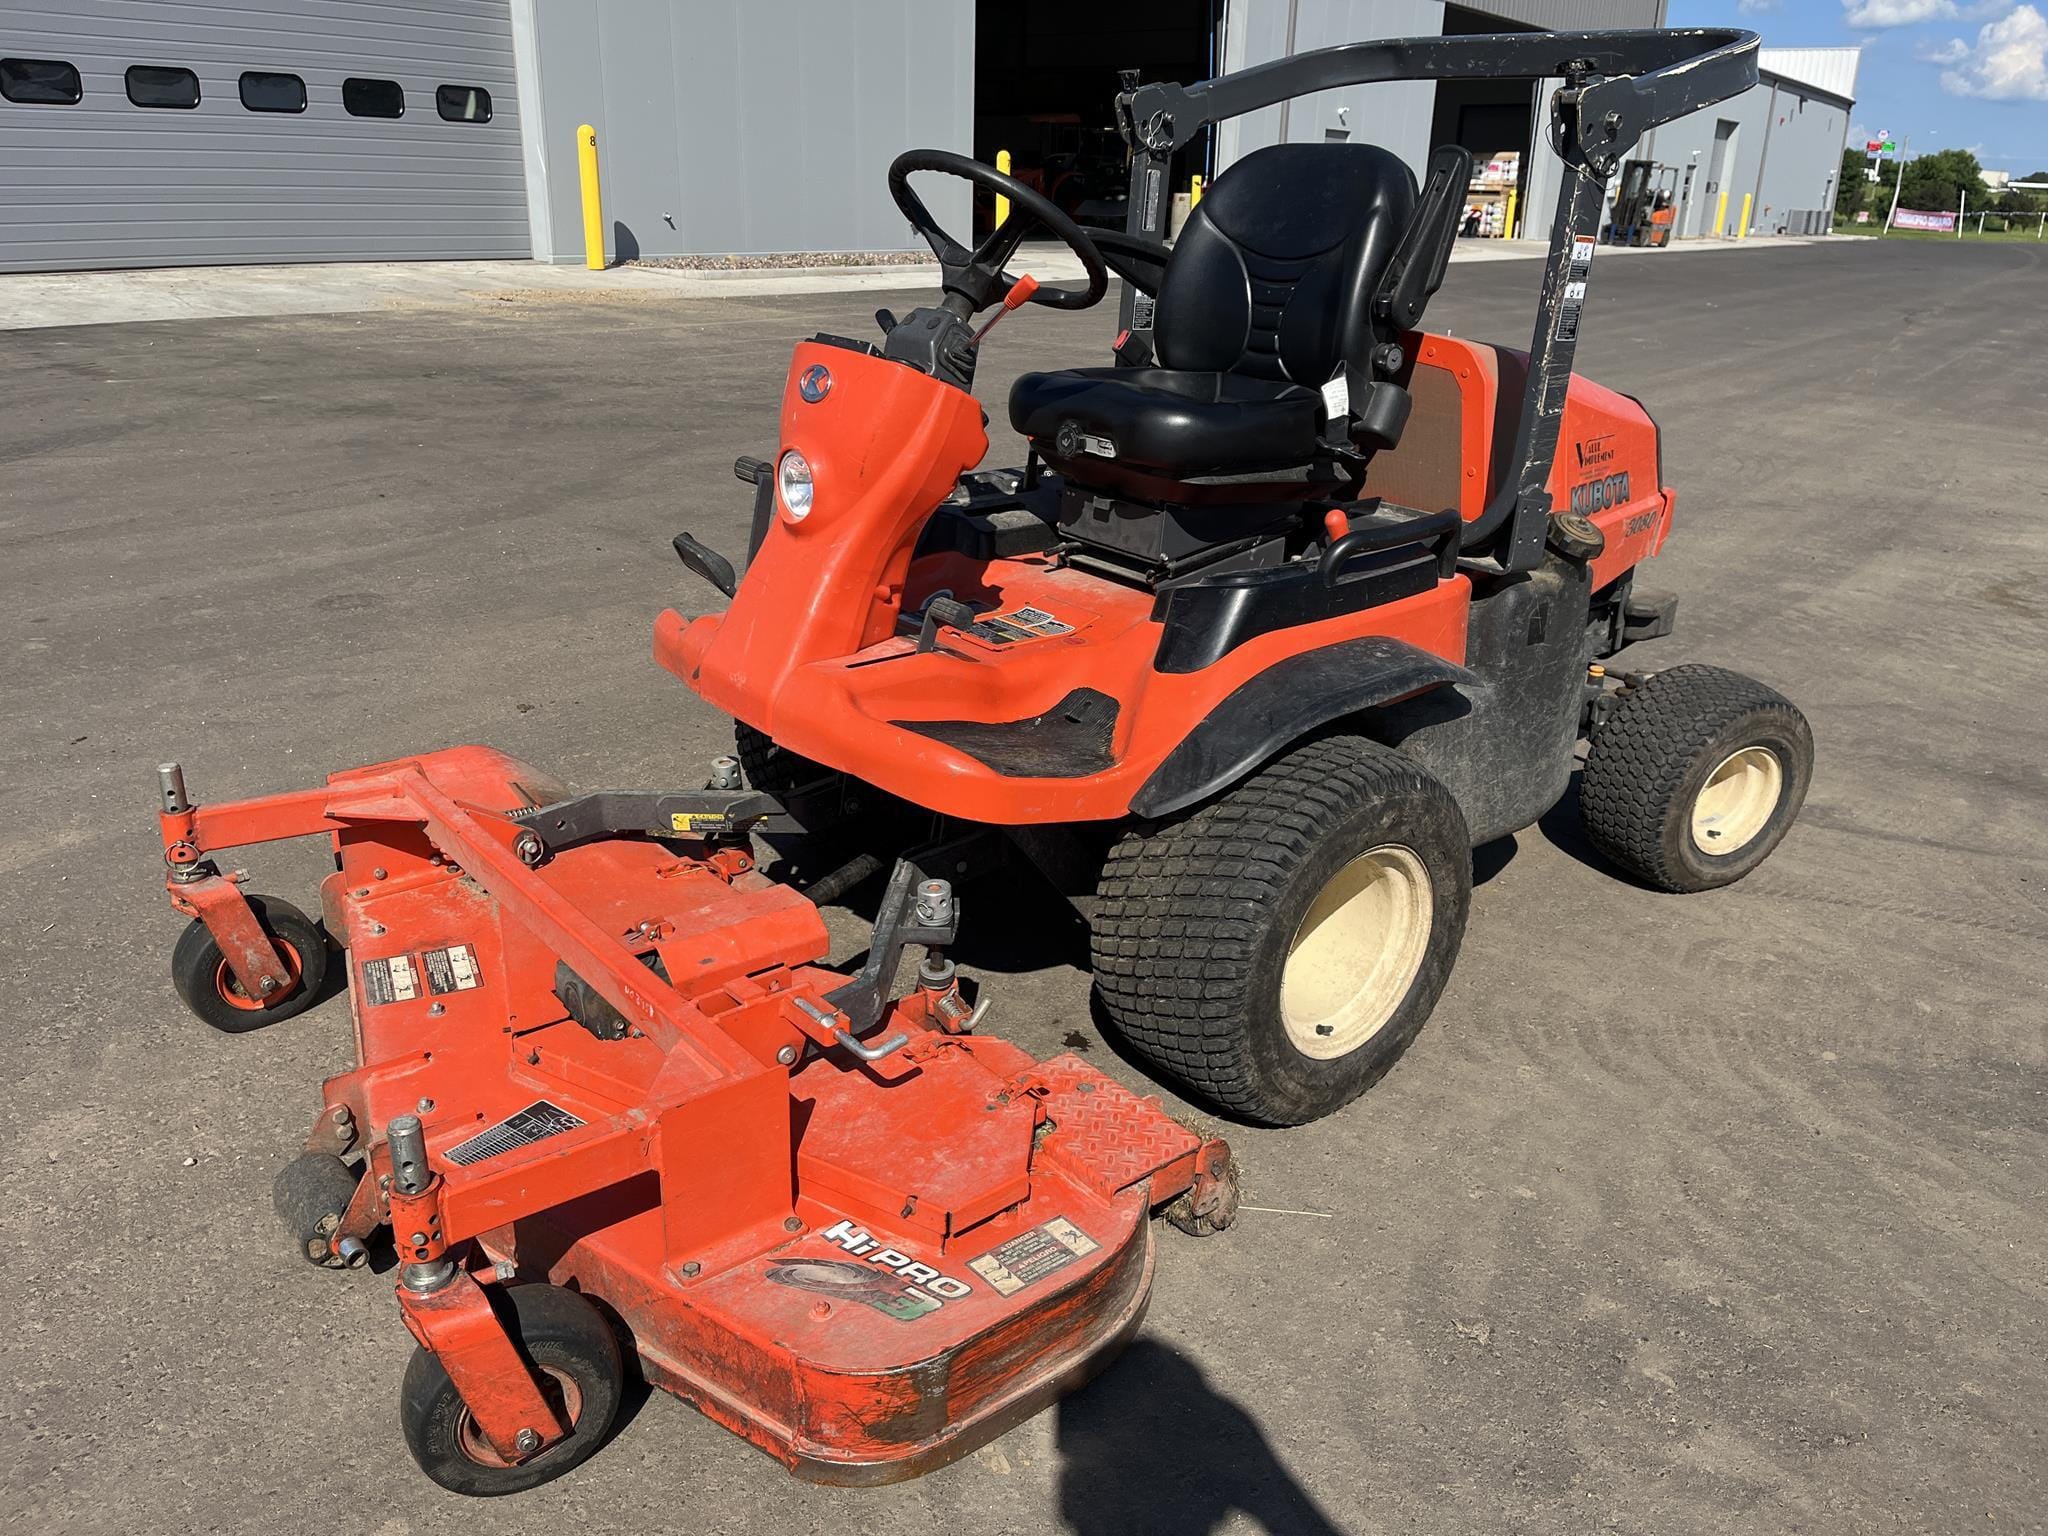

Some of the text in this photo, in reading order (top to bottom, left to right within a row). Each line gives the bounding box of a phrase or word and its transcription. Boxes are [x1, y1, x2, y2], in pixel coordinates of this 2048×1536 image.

[1571, 470, 1630, 517] KUBOTA
[1003, 1230, 1037, 1248] DANGER
[1022, 1245, 1058, 1268] PELIGRO
